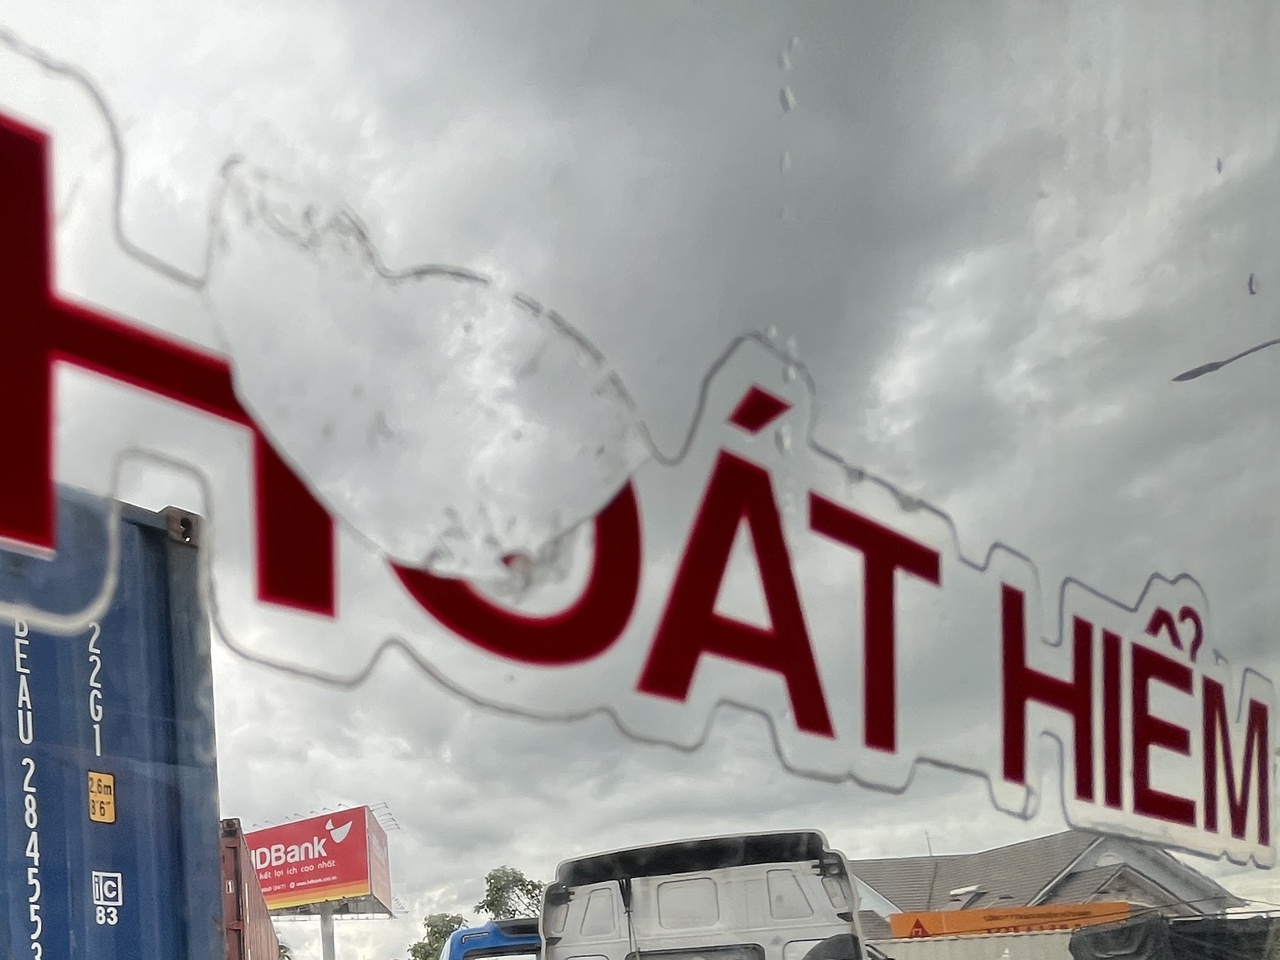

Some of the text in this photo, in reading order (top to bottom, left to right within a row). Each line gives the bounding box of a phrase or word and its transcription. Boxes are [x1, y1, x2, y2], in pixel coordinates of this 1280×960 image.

[88, 622, 103, 757] 22G1
[1001, 606, 1270, 847] HIỂM
[95, 906, 118, 925] 83
